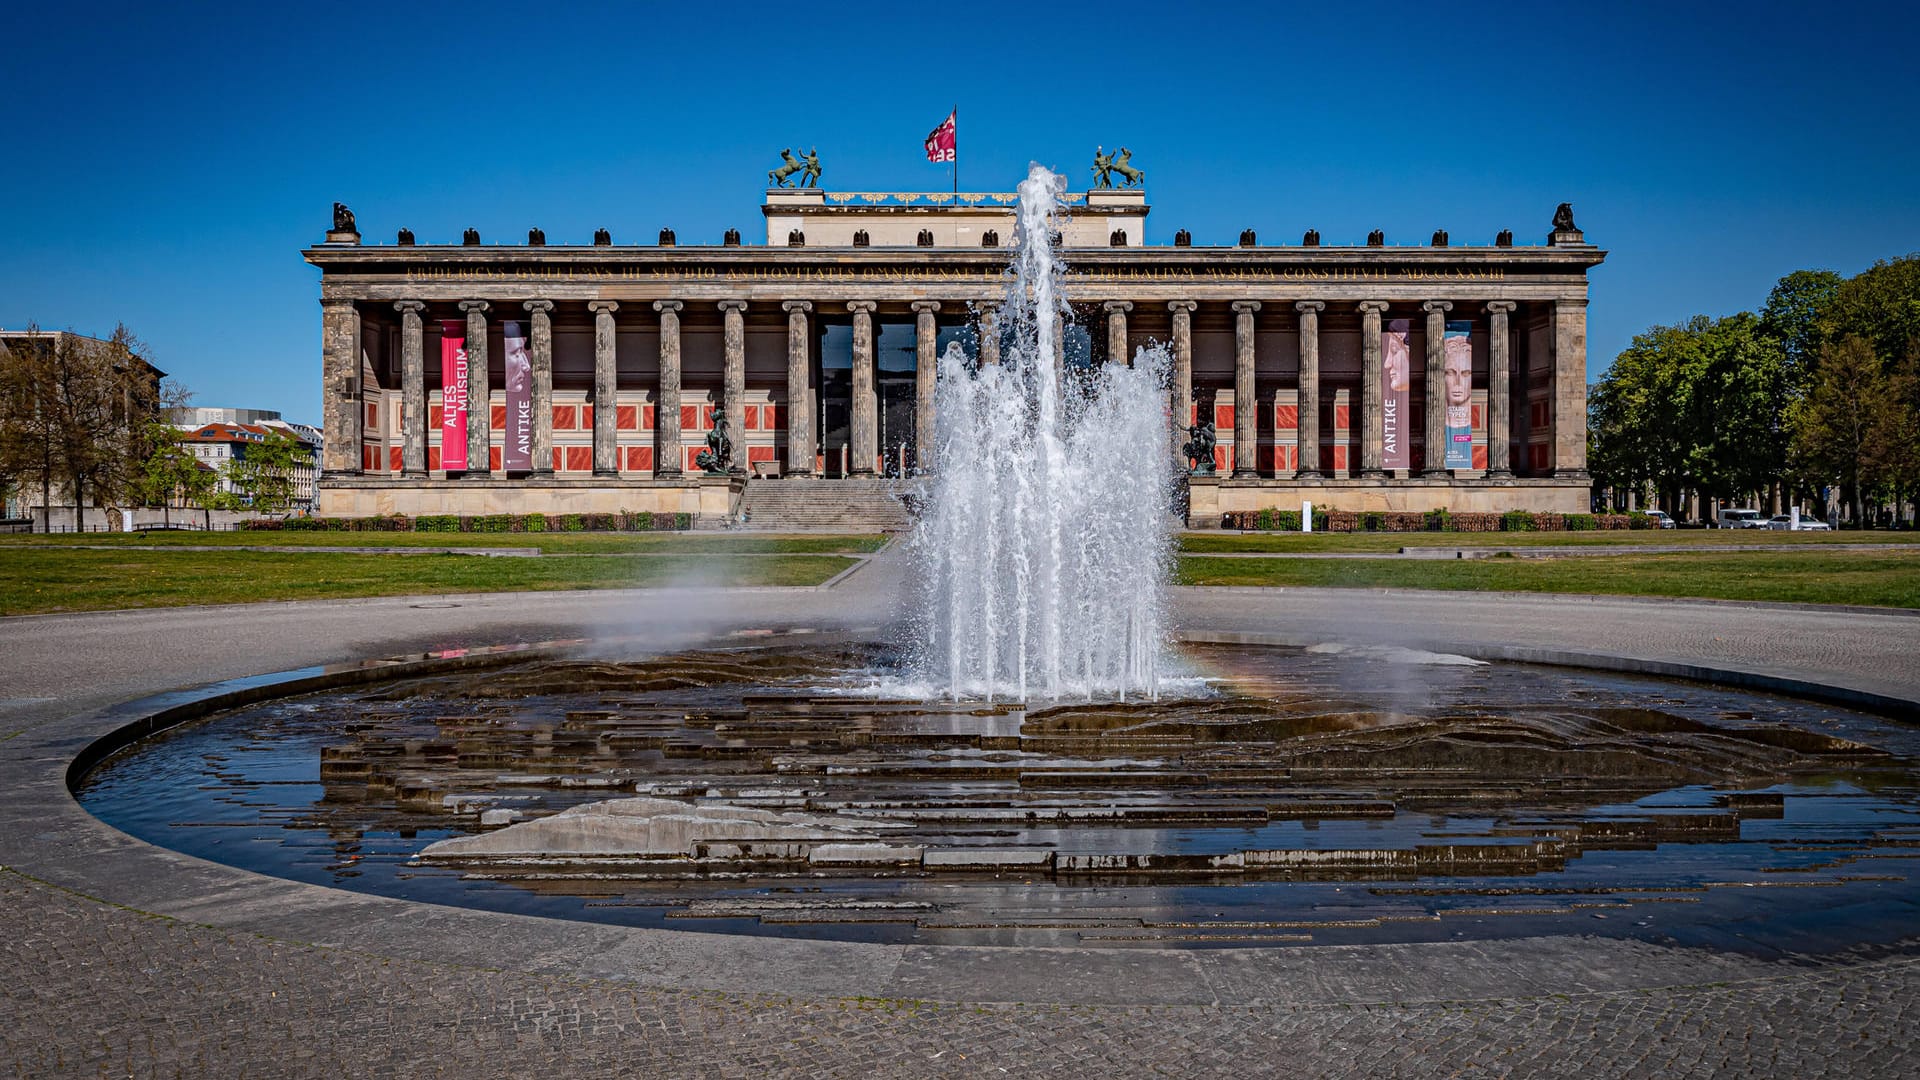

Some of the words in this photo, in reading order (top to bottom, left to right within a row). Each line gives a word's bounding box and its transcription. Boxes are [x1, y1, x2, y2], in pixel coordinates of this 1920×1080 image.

[1089, 266, 1195, 280] LIBERALIVM
[1203, 266, 1276, 280] MVSEVM
[1283, 266, 1390, 280] CONSTITVIT
[444, 385, 457, 428] ALTES
[456, 349, 468, 411] MUSEUM
[518, 400, 530, 455] ANTIKE
[1384, 399, 1397, 454] ANTIKE
